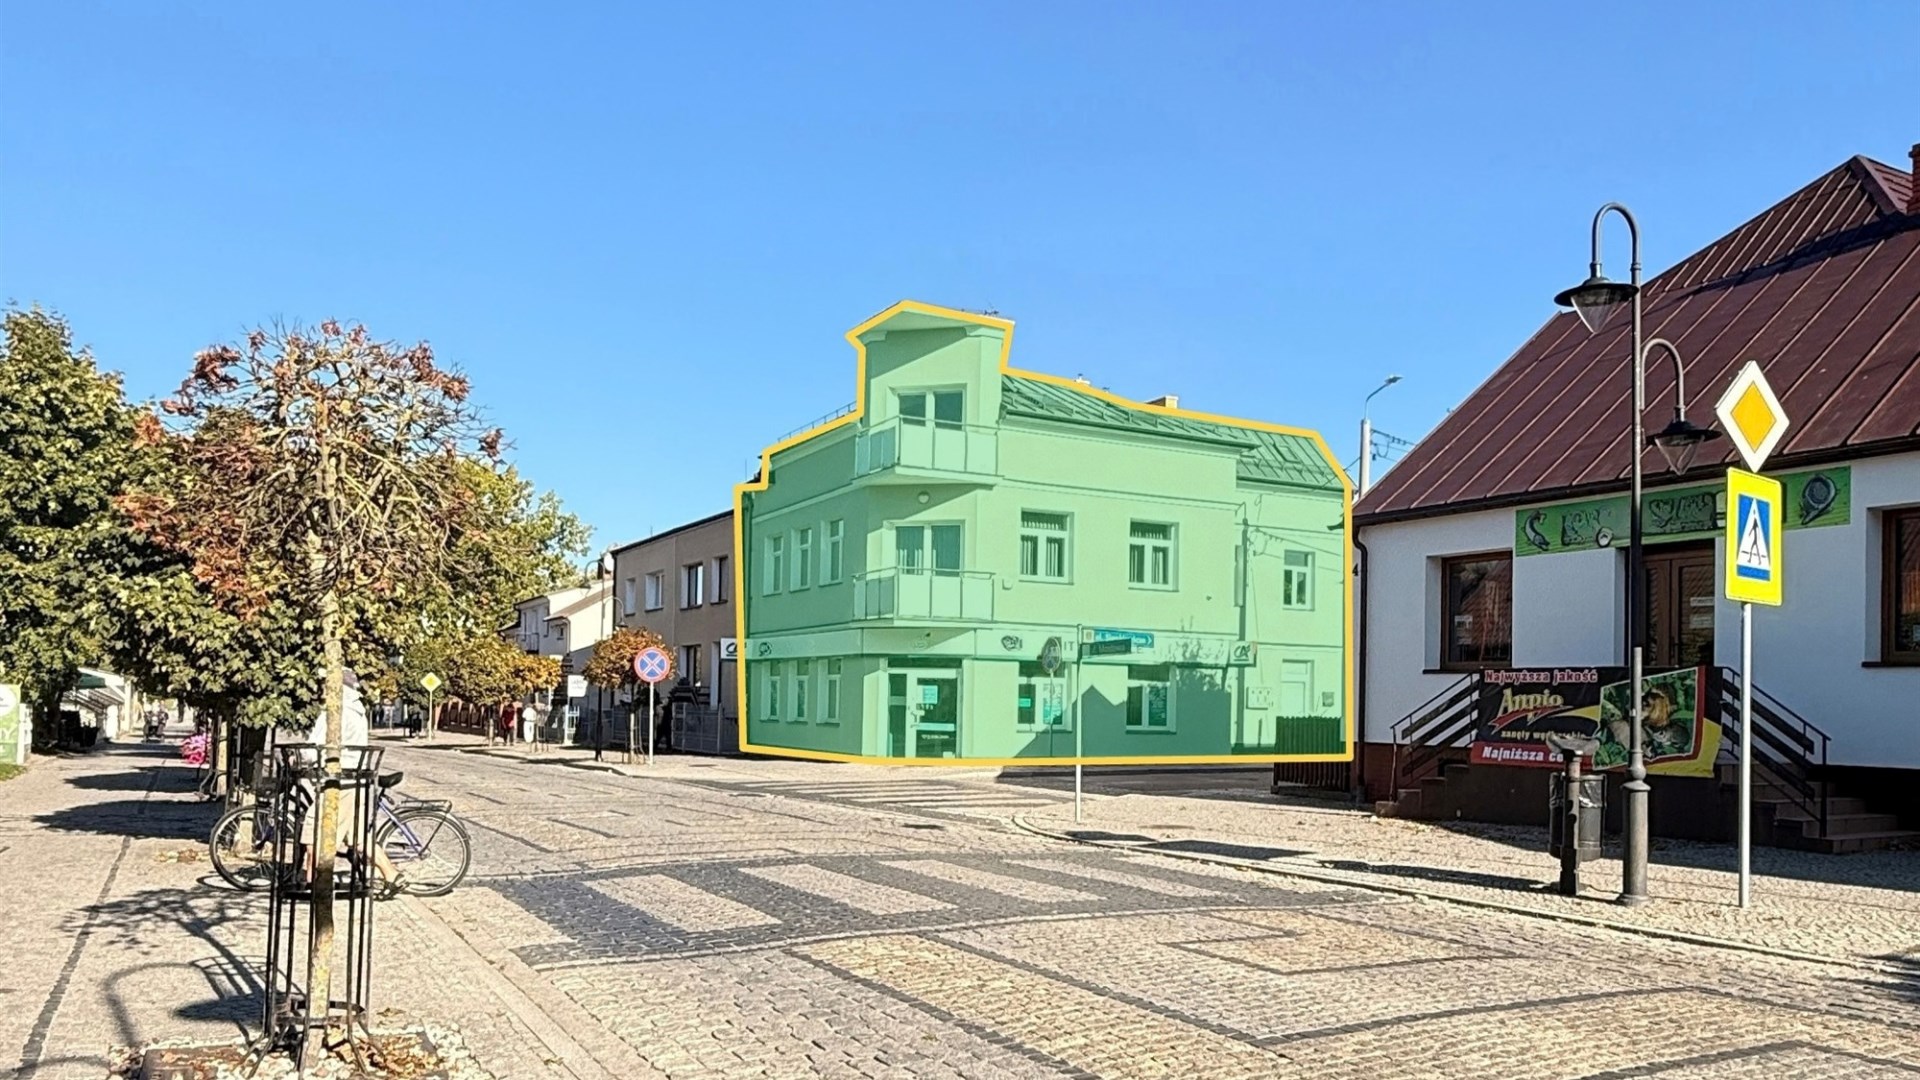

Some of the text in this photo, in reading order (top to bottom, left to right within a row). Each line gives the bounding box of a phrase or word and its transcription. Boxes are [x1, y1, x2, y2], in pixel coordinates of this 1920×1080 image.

[1484, 669, 1598, 685] Najwyższa jakość
[1482, 746, 1544, 761] Najniższa
